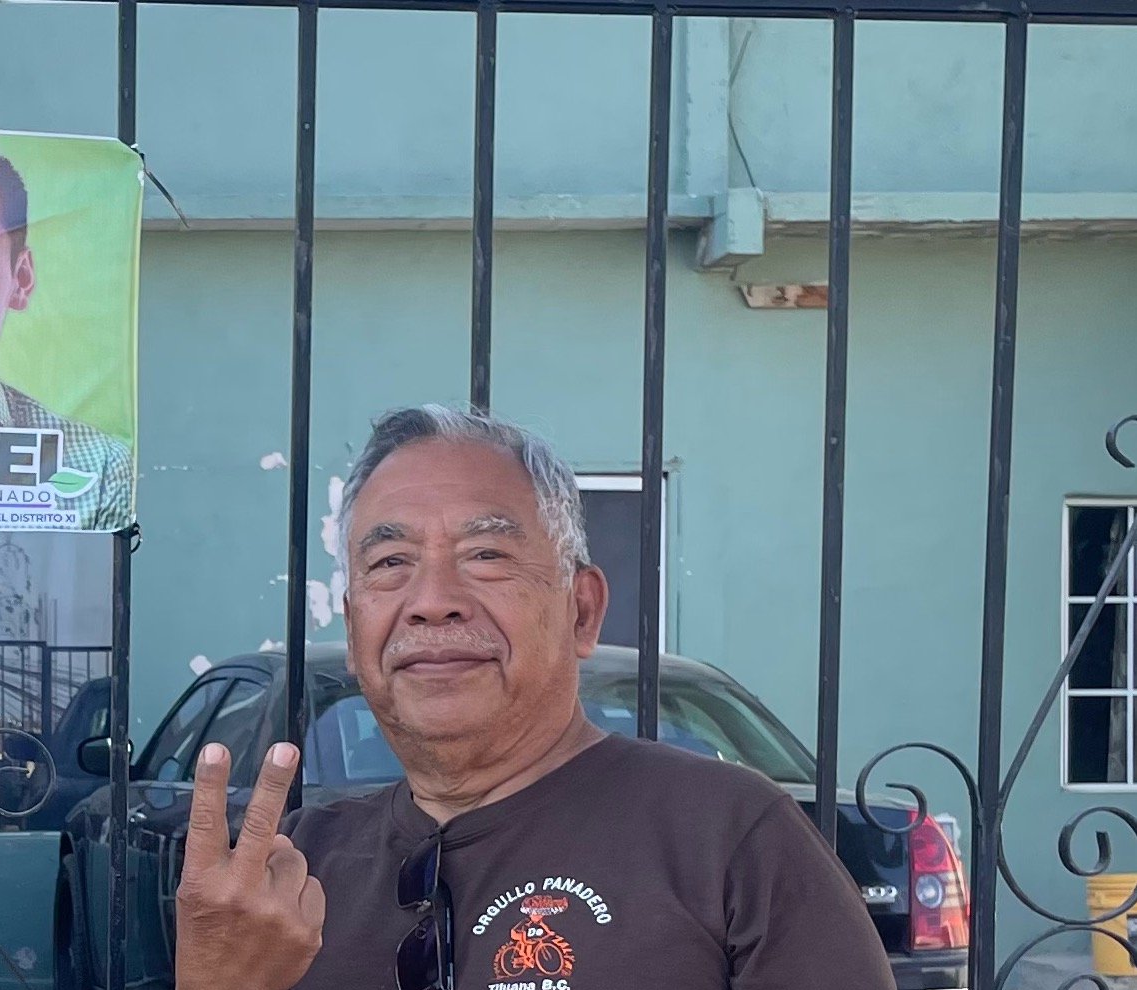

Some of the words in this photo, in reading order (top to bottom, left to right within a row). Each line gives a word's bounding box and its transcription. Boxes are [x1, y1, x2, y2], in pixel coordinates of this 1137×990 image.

[8, 513, 63, 524] DISTRITO
[64, 514, 76, 524] XI
[472, 882, 535, 935] ORGULLO
[543, 876, 612, 925] PANADERO
[542, 978, 571, 990] B.C.
